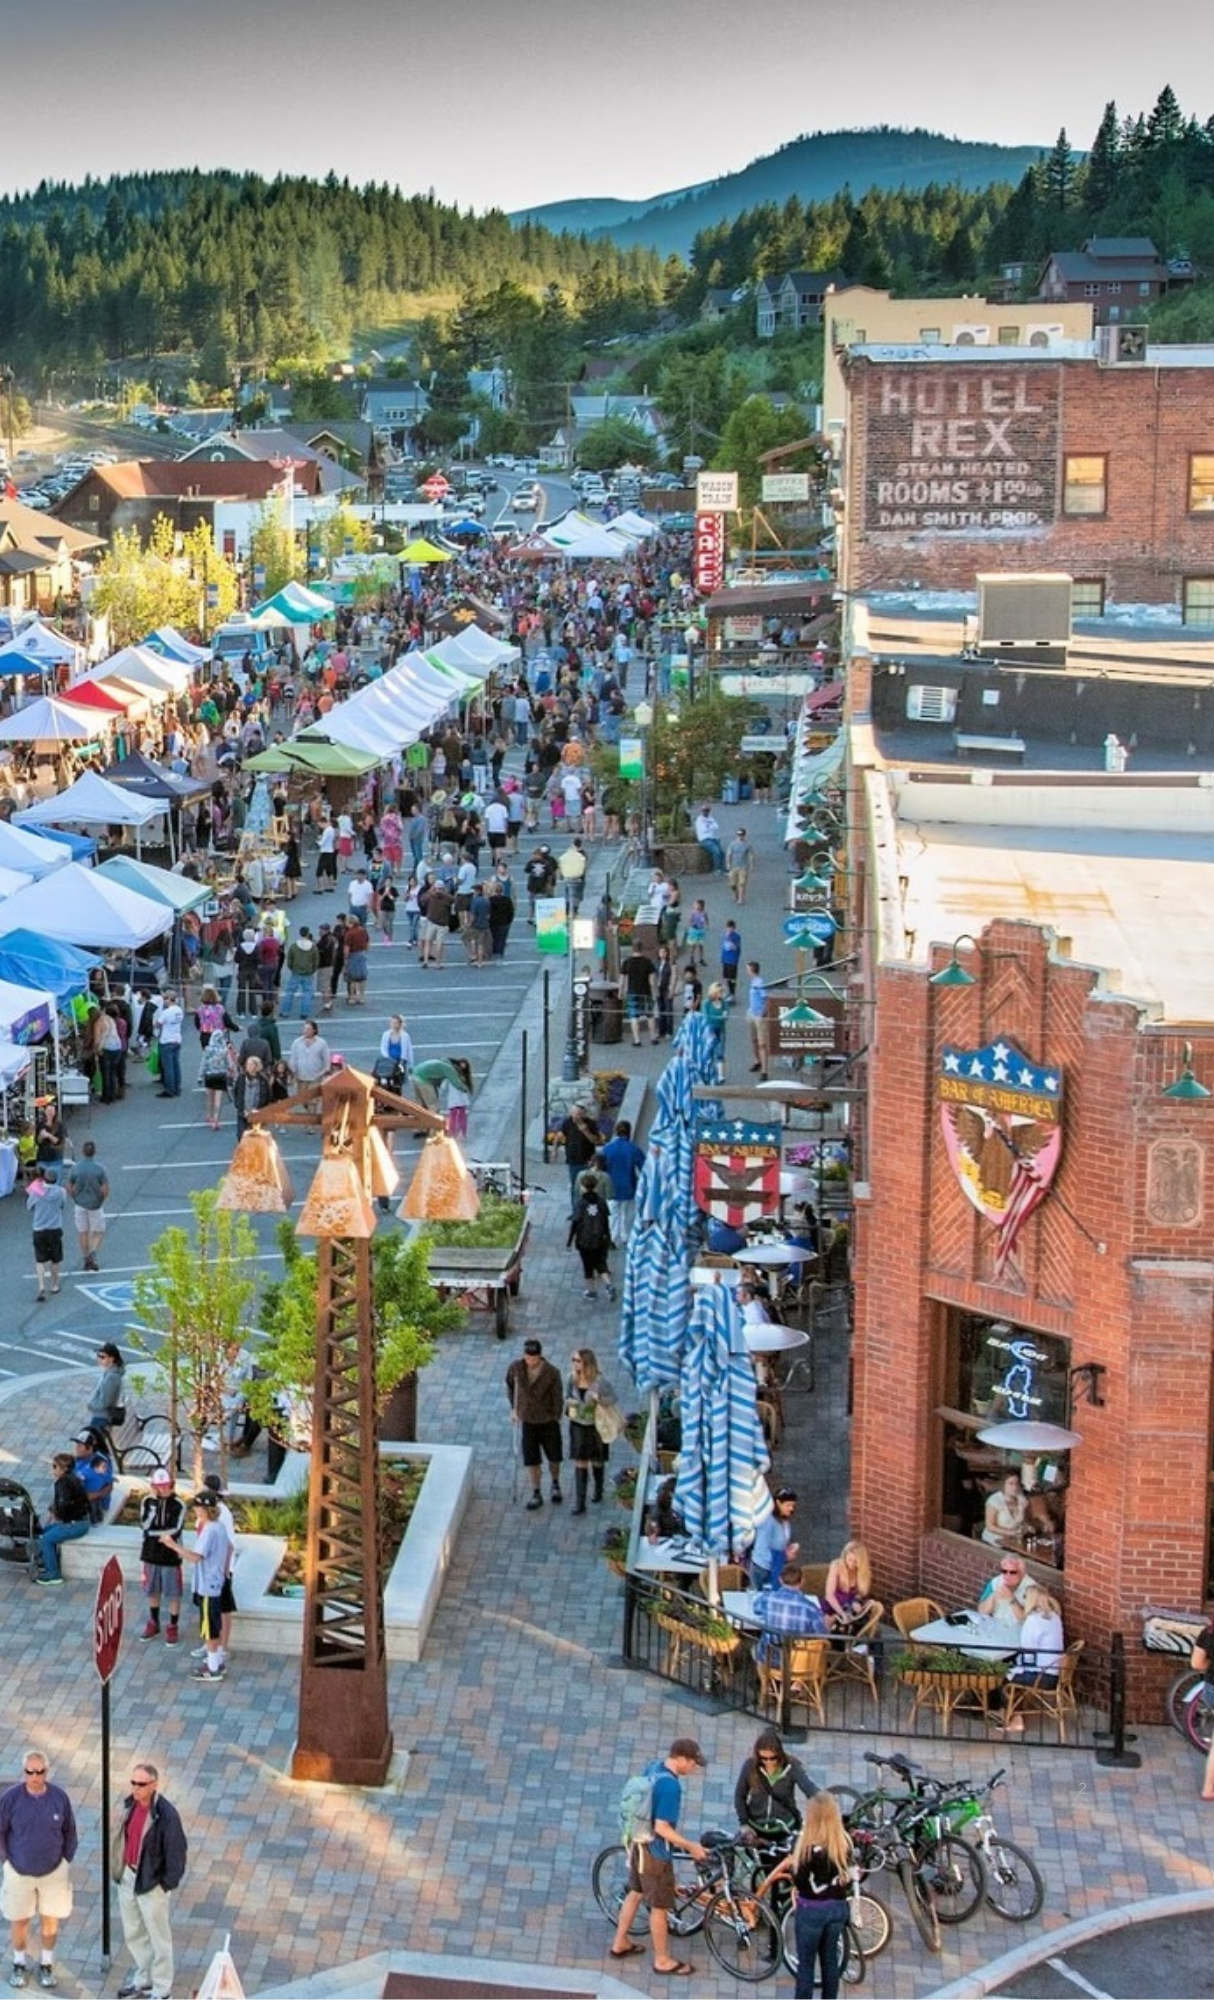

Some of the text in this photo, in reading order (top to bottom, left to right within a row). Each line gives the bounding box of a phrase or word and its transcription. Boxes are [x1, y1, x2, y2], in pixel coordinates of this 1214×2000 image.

[880, 374, 1044, 414] HOTEL
[911, 418, 1017, 457] REX
[896, 463, 1031, 476] STEAM HEATED
[877, 481, 969, 504] ROOMS
[879, 512, 917, 526] DAN
[698, 516, 715, 587] CAFE
[939, 1077, 968, 1101] BAR
[987, 1091, 1056, 1120] AMERICA
[98, 1584, 122, 1653] STOP
